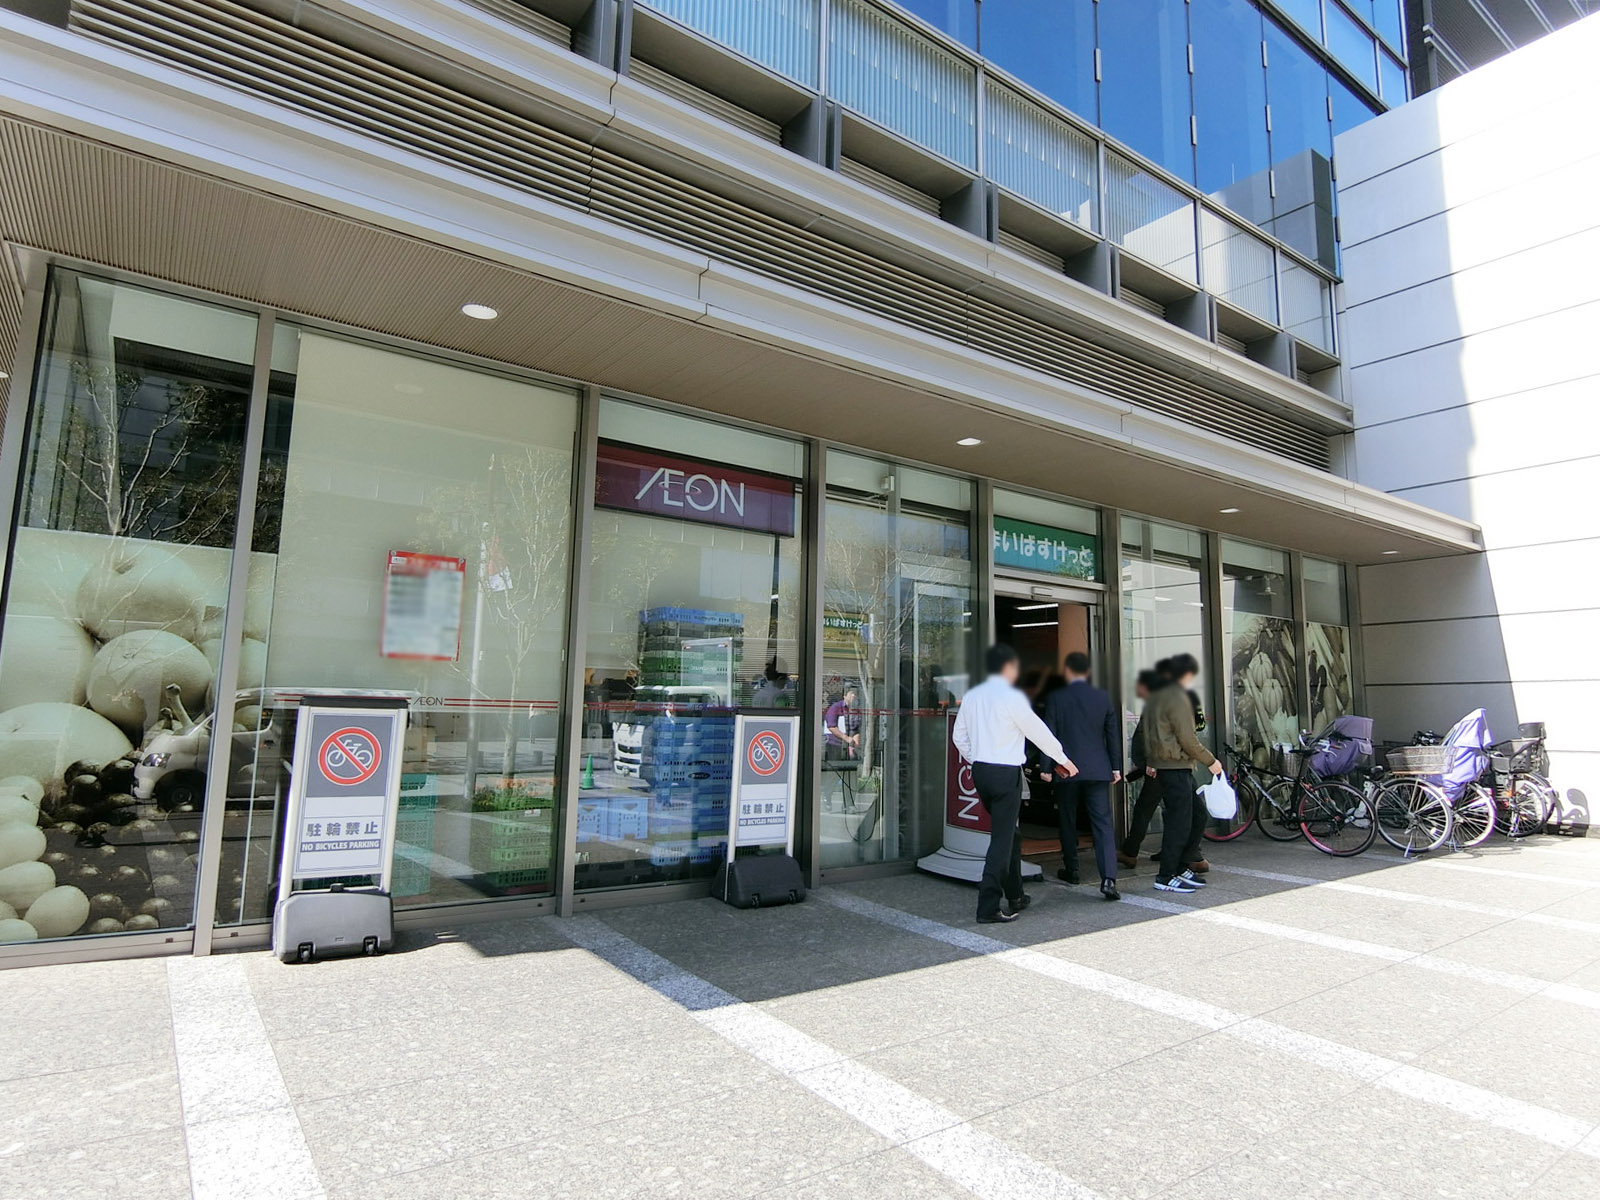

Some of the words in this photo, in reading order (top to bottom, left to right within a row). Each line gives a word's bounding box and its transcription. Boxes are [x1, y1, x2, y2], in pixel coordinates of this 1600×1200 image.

[305, 821, 379, 837] 駐輪禁止
[301, 843, 314, 851] NO
[315, 841, 347, 850] BICYCLES
[349, 840, 379, 849] PARKING
